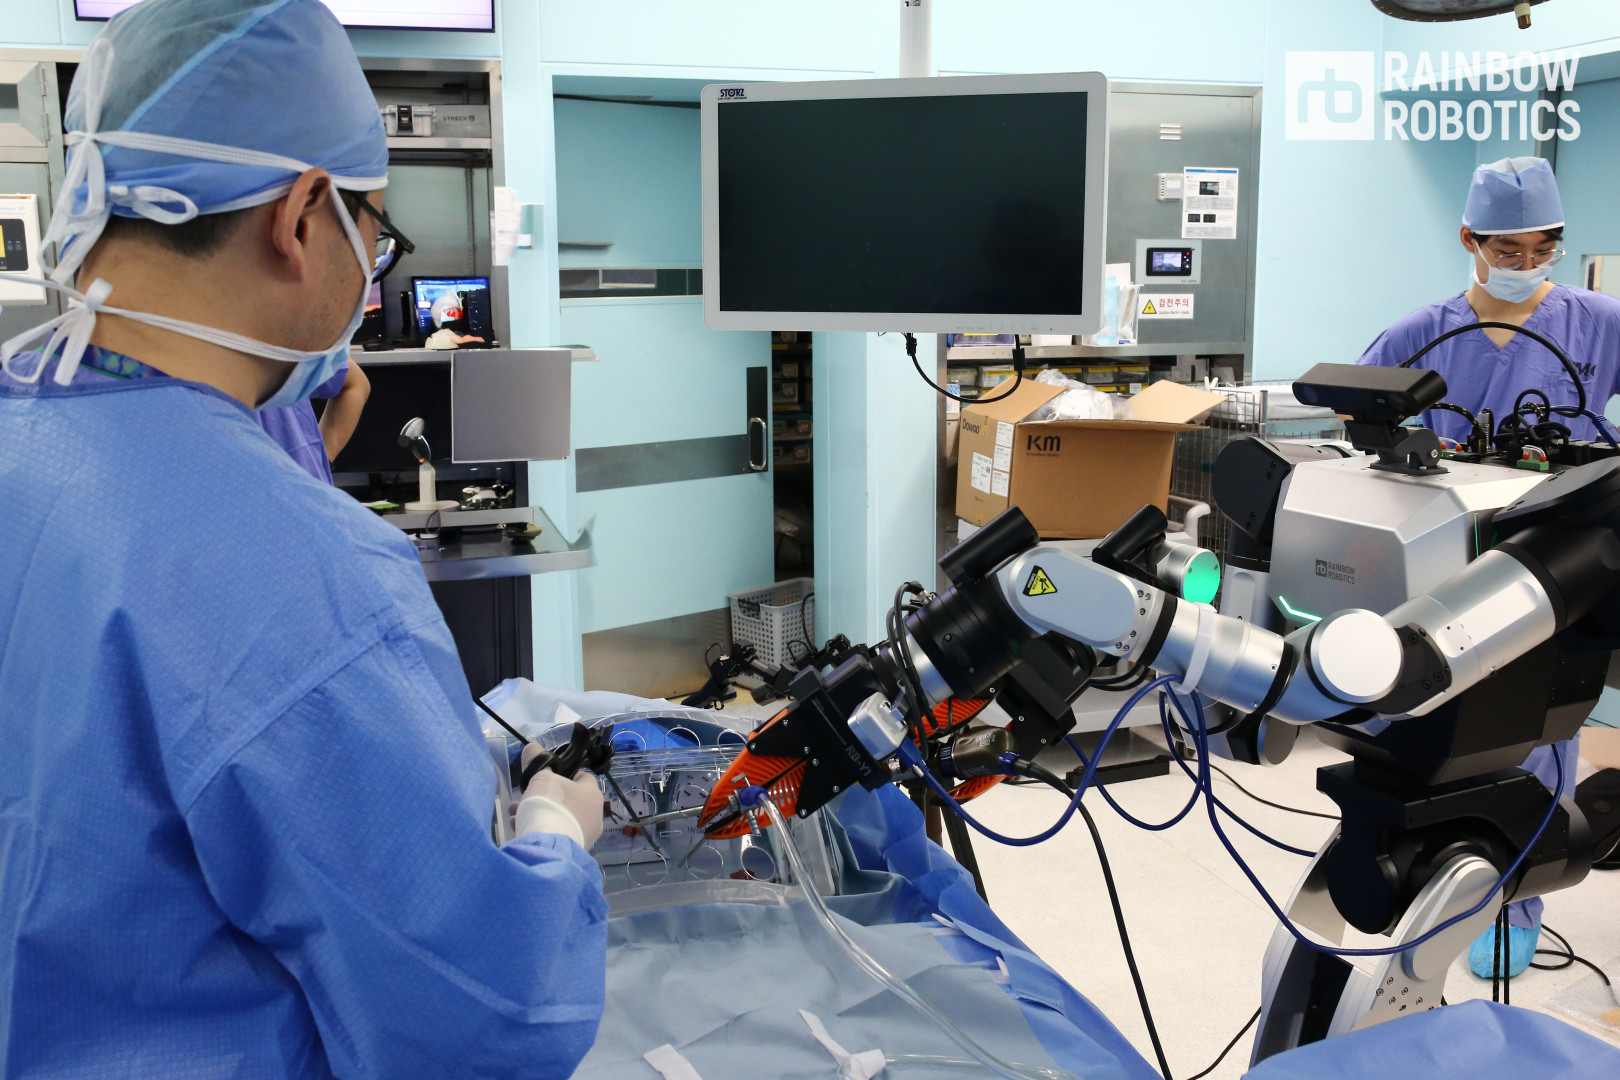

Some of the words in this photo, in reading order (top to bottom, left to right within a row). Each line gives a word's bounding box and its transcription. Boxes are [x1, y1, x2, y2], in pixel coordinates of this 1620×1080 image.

[720, 88, 745, 98] STORZ
[1159, 298, 1189, 308] 감전주의
[1327, 561, 1355, 574] RAINBOW
[1327, 570, 1355, 584] ROBOTICS
[845, 745, 872, 777] RB-Y1
